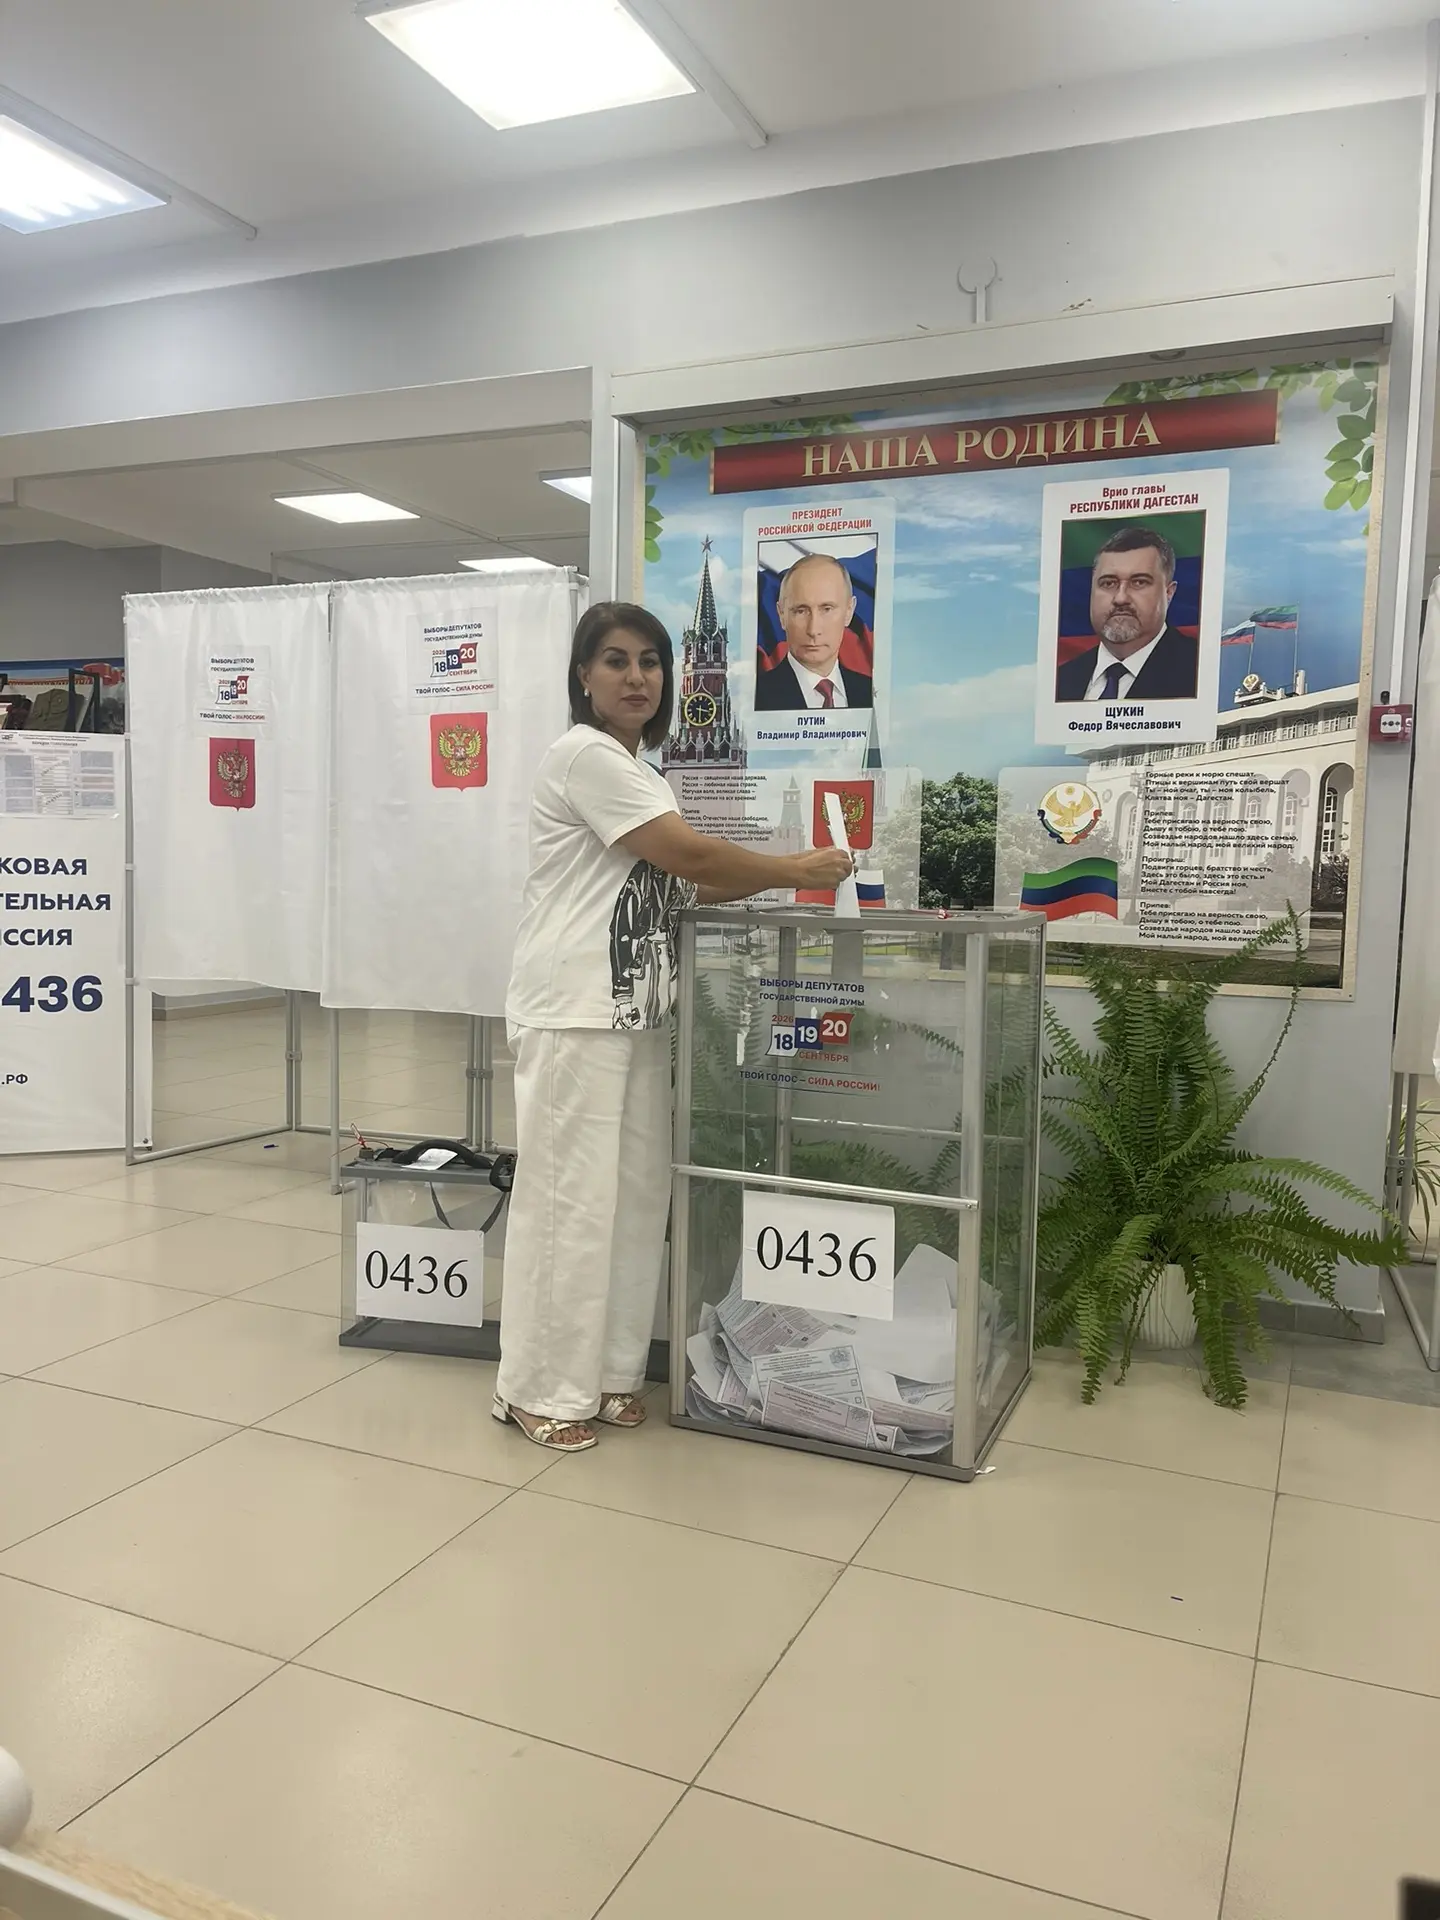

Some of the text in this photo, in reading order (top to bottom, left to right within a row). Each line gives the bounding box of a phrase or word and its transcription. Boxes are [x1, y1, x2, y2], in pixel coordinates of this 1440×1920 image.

[802, 411, 1161, 478] НАША РОДИНА
[1103, 483, 1166, 499] Врио главы
[1070, 493, 1199, 514] РЕСПУБЛИКИ ДАГЕСТАН
[792, 508, 842, 520] ПРЕЗИДЕНТ
[758, 518, 871, 536] РОССИЙСКОЙ ФЕДЕРАЦИИ
[449, 623, 481, 631] ДЕПУТАТОВ
[425, 634, 468, 642] ГОСУДАРСТВЕННОЙ
[435, 648, 475, 672] 18 19 20
[220, 680, 246, 700] 18 20
[1105, 706, 1144, 719] ЩУКИН
[797, 717, 825, 726] ПУТИН
[1068, 719, 1180, 732] Федор Вячеславович
[757, 728, 867, 741] Владимир Владимирович
[1143, 825, 1167, 833] Дышу
[0, 893, 111, 910] ЕЛЬНАЯ
[0, 929, 73, 946] ССИЯ
[1, 975, 103, 1012] 436
[760, 978, 865, 993] ВЫБОРЫ ДЕПУТАТОВ
[760, 993, 865, 1006] ГОСУДАРСТВЕННОЙ ДУМЫ
[772, 1015, 794, 1023] 2026
[774, 1019, 847, 1050] 18 19 20
[799, 1051, 849, 1063] СЕНТЯБРЯ
[740, 1070, 881, 1091] ТВОЙ ГОЛОС СИЛА РОССИИ!
[756, 1225, 877, 1282] 0436
[365, 1250, 468, 1298] 0436
